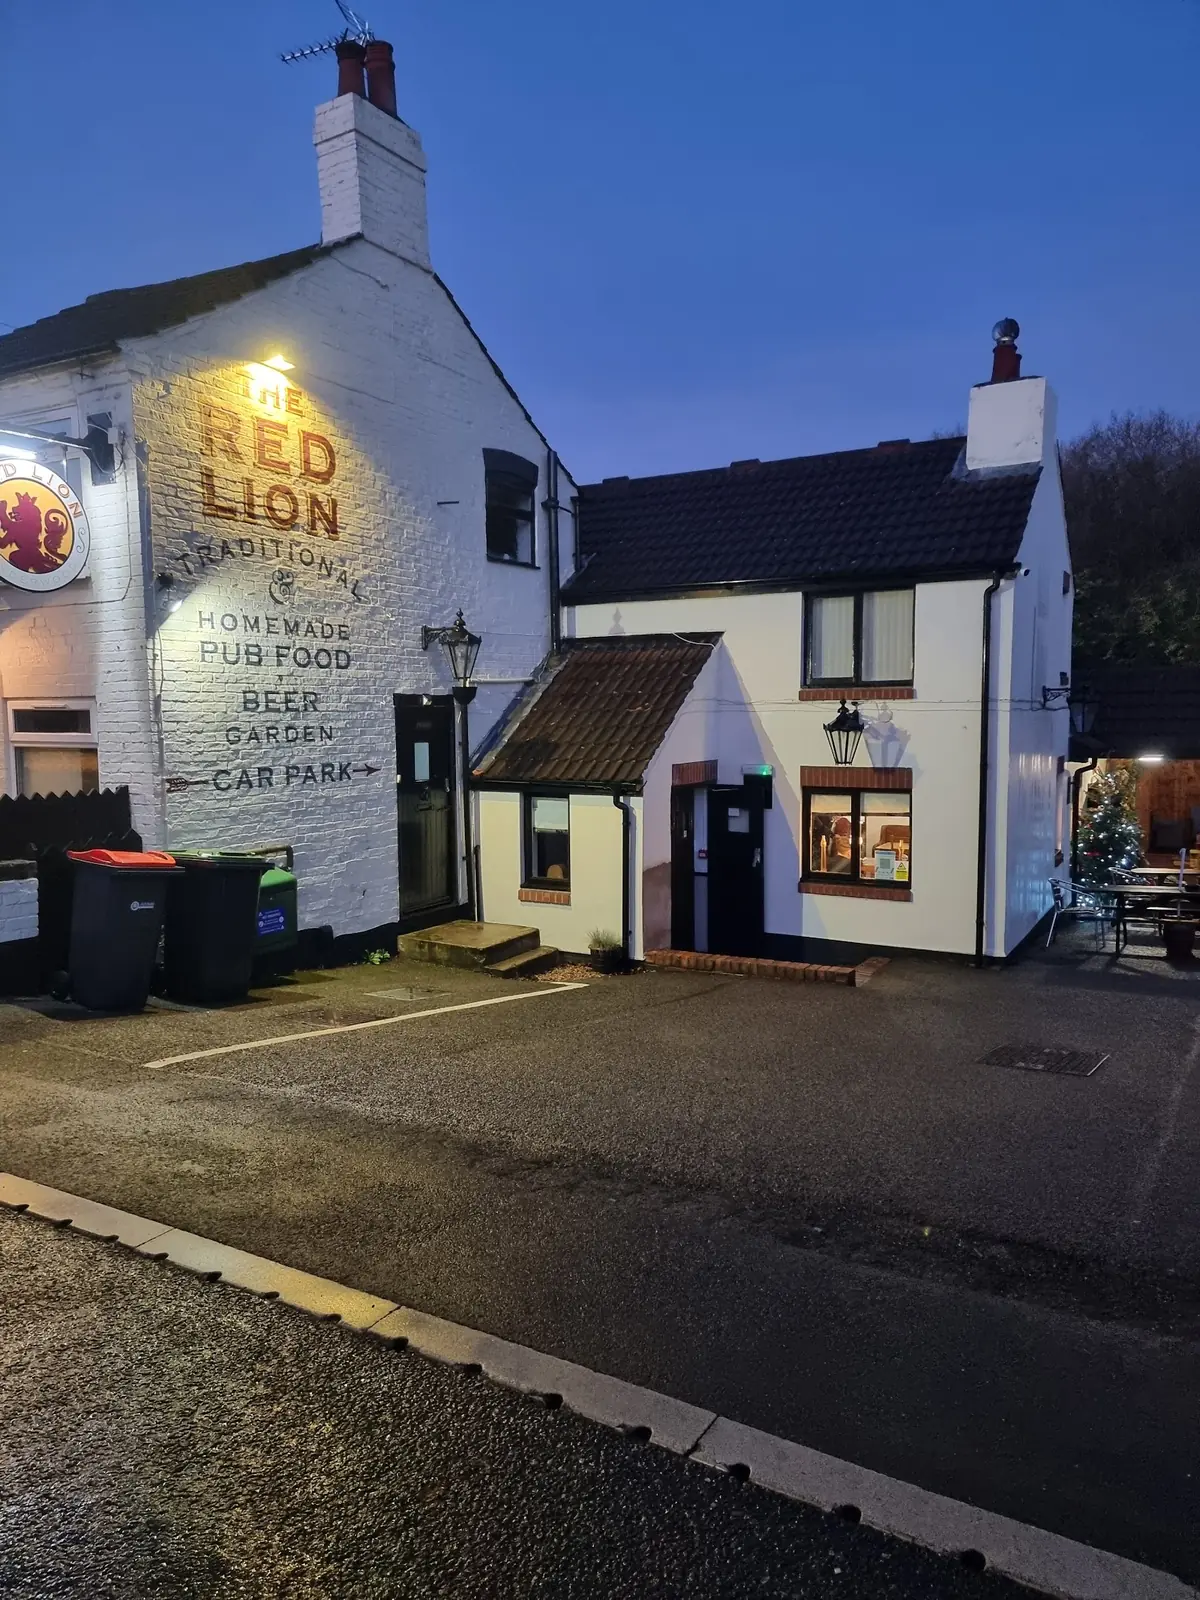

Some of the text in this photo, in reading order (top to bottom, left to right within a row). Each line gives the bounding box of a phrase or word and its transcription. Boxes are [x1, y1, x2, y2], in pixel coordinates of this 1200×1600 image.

[199, 403, 337, 484] RED
[32, 464, 83, 519] LION
[200, 466, 340, 541] LION
[175, 538, 369, 602] TRADITIONAL
[269, 569, 295, 605] &
[198, 610, 351, 641] HOMEMADE
[200, 640, 351, 670] PUB FOOD
[242, 690, 320, 713] BEER
[225, 725, 333, 746] GARDEN
[213, 762, 352, 791] CAR PARK
